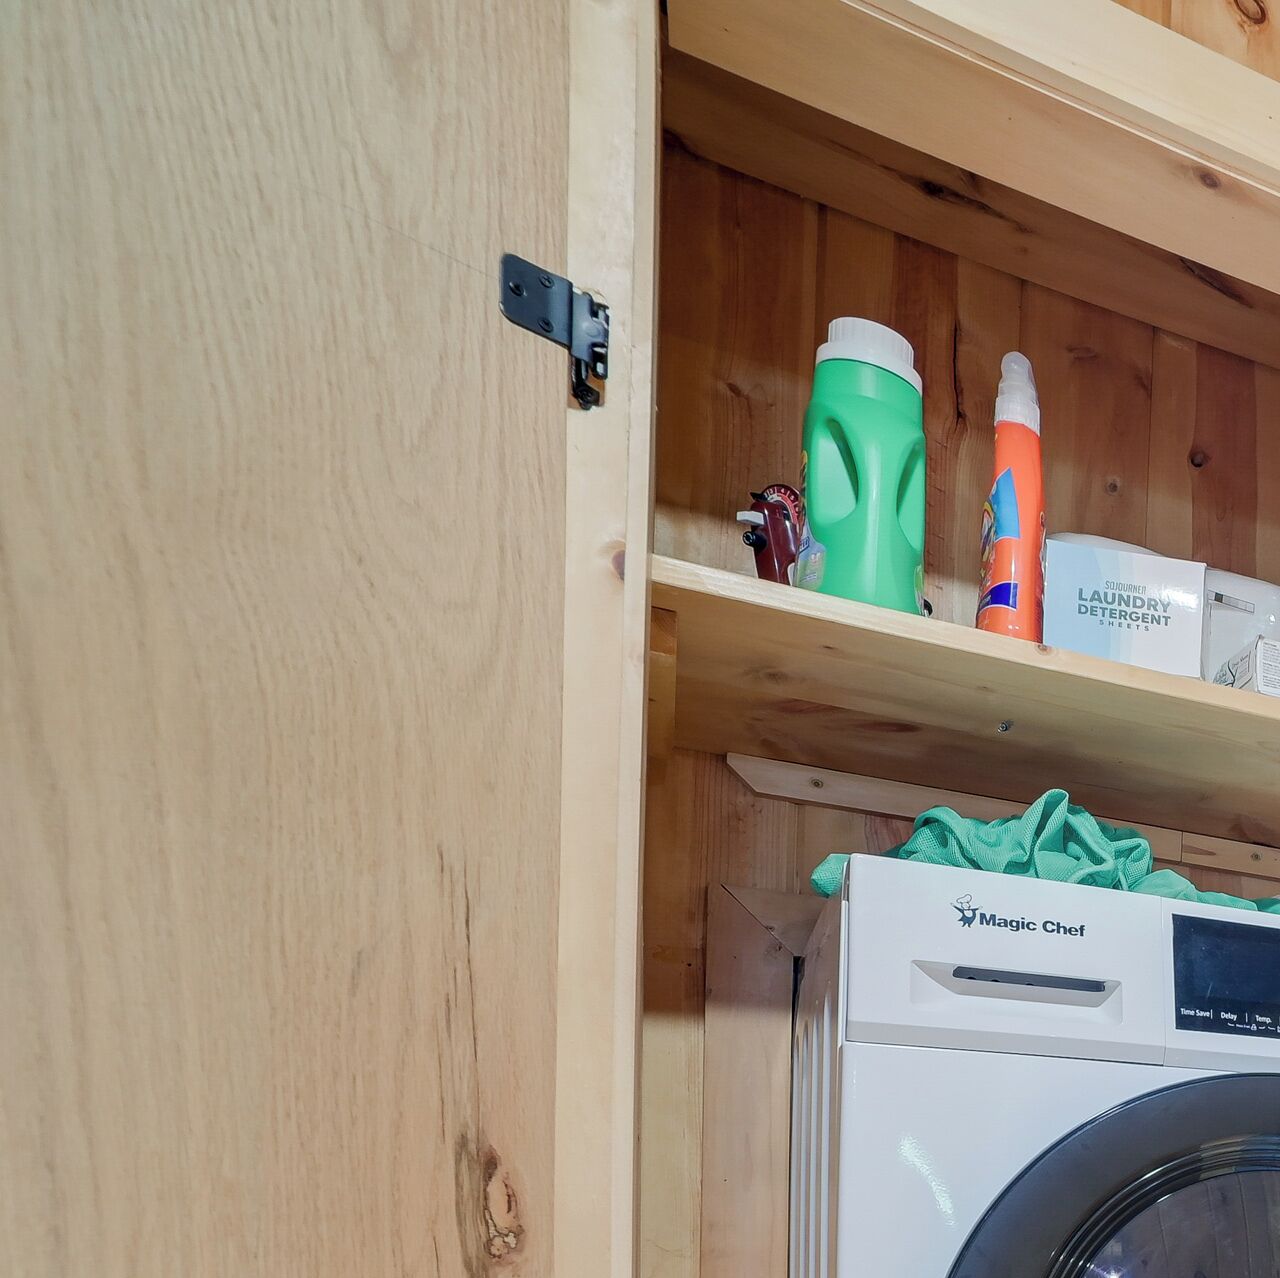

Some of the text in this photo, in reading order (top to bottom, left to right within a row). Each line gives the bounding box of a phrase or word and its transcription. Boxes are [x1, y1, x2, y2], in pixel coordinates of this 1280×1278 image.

[1078, 587, 1171, 613] LAUNDRY
[1077, 603, 1171, 626] DETERGENT
[1099, 619, 1149, 631] SHEETS
[979, 912, 1086, 937] Magic Chef
[1180, 1008, 1195, 1016] Time
[1220, 1012, 1237, 1021] Delay
[1255, 1014, 1272, 1023] Temp.
